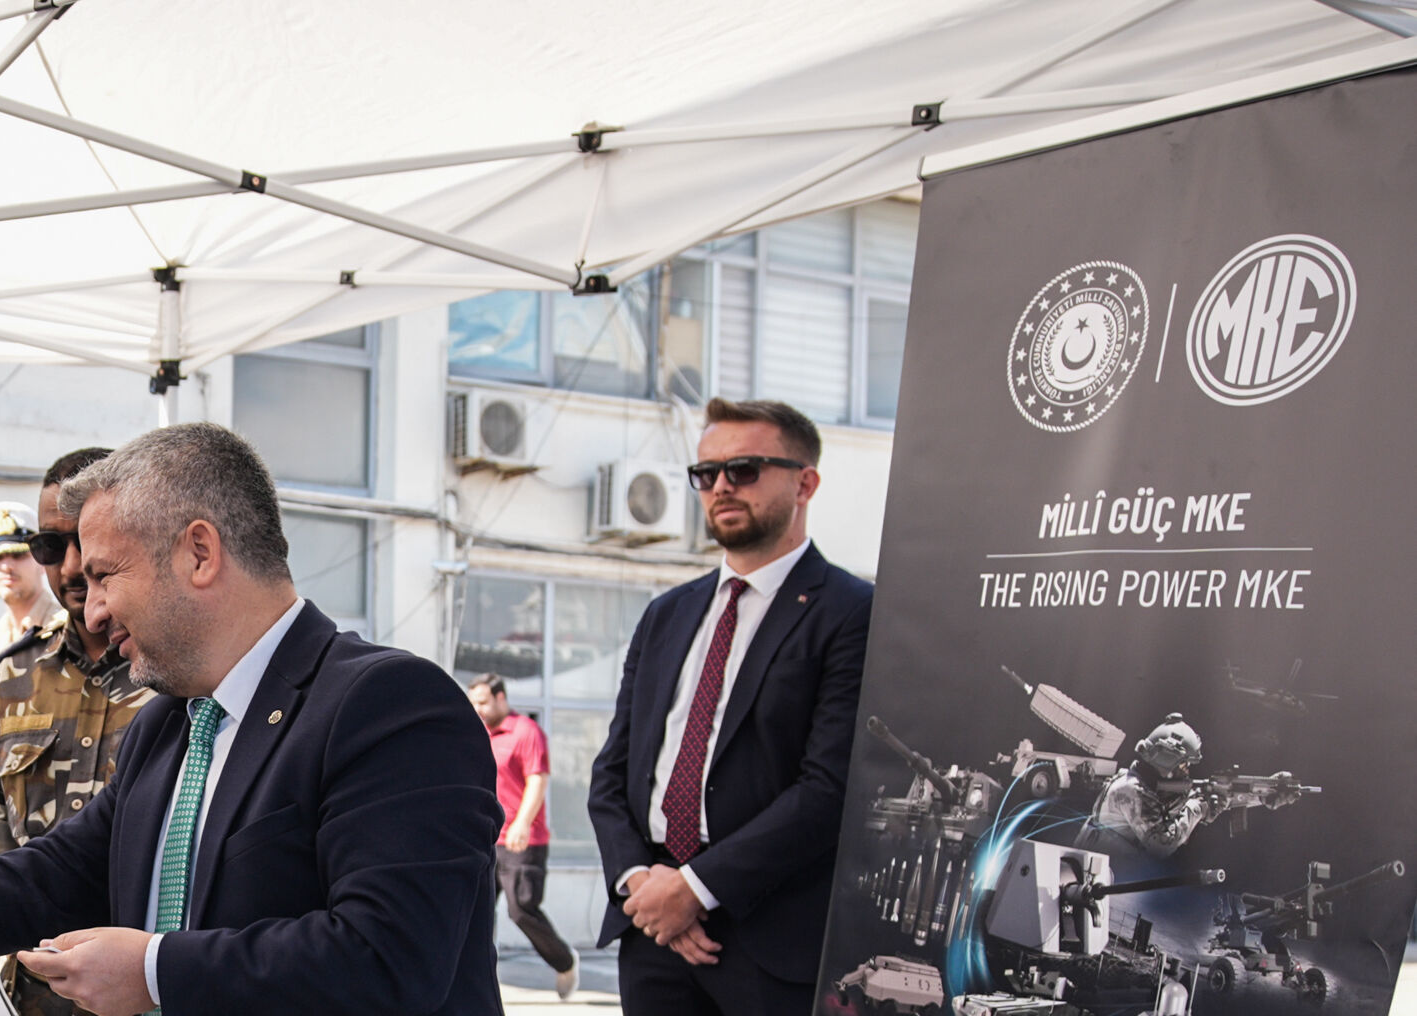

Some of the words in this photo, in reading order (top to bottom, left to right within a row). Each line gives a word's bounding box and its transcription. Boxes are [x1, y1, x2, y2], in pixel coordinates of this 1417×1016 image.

[1032, 297, 1073, 367] CUMHURİYETİ
[1102, 297, 1125, 340] SAVUNMA
[1206, 255, 1336, 386] MKE
[1038, 490, 1106, 539] MİLLÎ
[1107, 487, 1175, 542] GÜÇ
[1182, 492, 1251, 532] MKE
[979, 571, 1025, 608] THE
[1030, 570, 1109, 607] RISING
[1117, 569, 1225, 608] POWER
[1233, 569, 1312, 609] MKE
